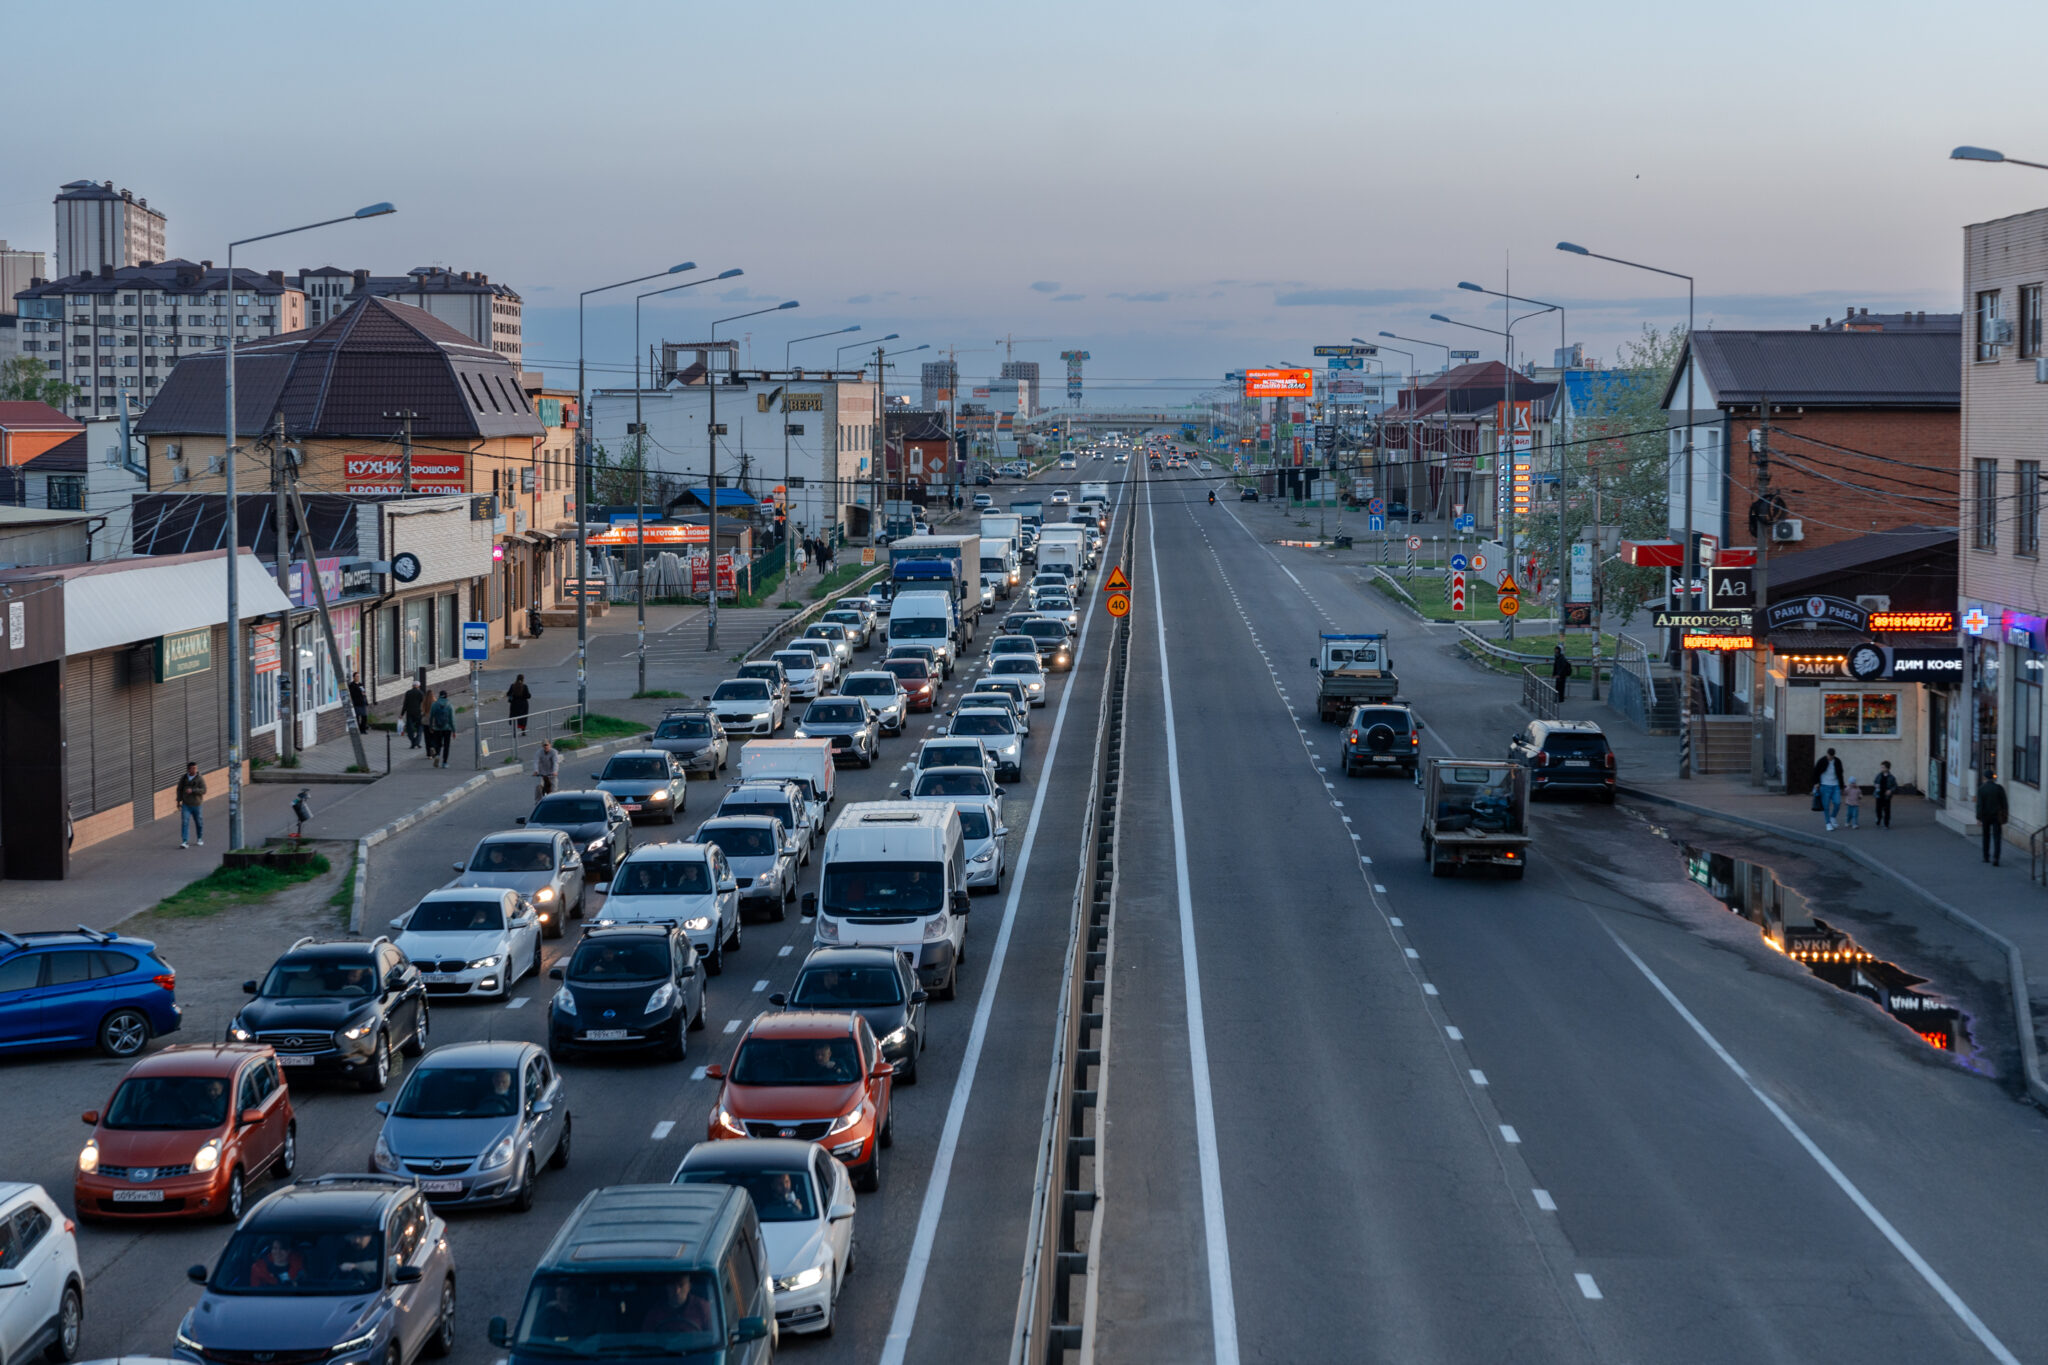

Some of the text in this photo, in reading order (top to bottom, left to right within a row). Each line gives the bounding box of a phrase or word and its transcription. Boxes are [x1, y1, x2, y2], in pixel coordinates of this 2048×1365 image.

[348, 461, 460, 475] КУХНИ ОРОШО.РФ
[1111, 600, 1126, 610] 40
[1503, 602, 1516, 610] 40
[1774, 605, 1804, 619] РАКИ
[1828, 606, 1859, 622] РЫБА
[1797, 663, 1835, 674] РАКИ
[1894, 659, 1963, 671] ДИМ КОФЕ
